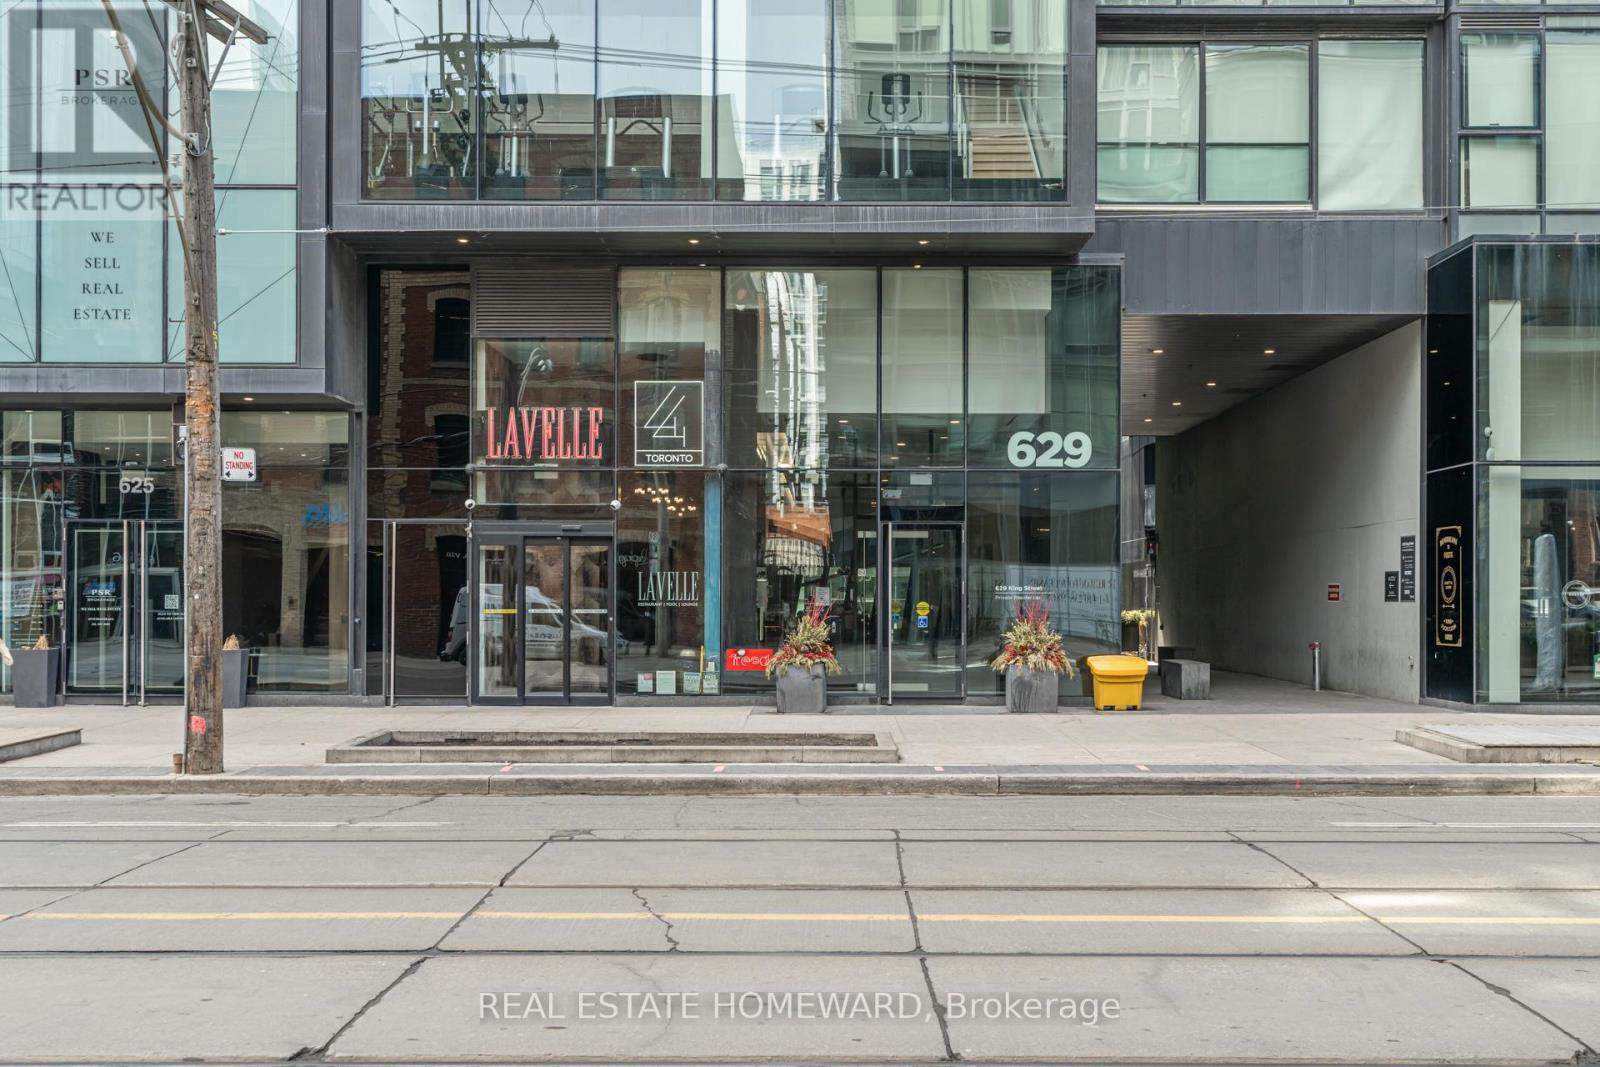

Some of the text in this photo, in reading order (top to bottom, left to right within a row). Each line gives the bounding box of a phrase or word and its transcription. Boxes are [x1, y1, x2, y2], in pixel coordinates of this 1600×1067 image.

[75, 69, 133, 86] PSR
[61, 96, 146, 106] BROKERAG
[90, 231, 115, 244] WE
[84, 257, 120, 269] SELL
[82, 283, 123, 295] REAL
[73, 308, 131, 321] ESTATE
[486, 406, 603, 460] LAVELLE
[233, 451, 244, 460] NO
[1007, 431, 1092, 468] 629
[645, 453, 693, 464] TORONTO
[225, 461, 254, 470] STANDING
[119, 477, 155, 494] 625
[638, 571, 699, 601] LAVELLE
[1008, 585, 1023, 593] King
